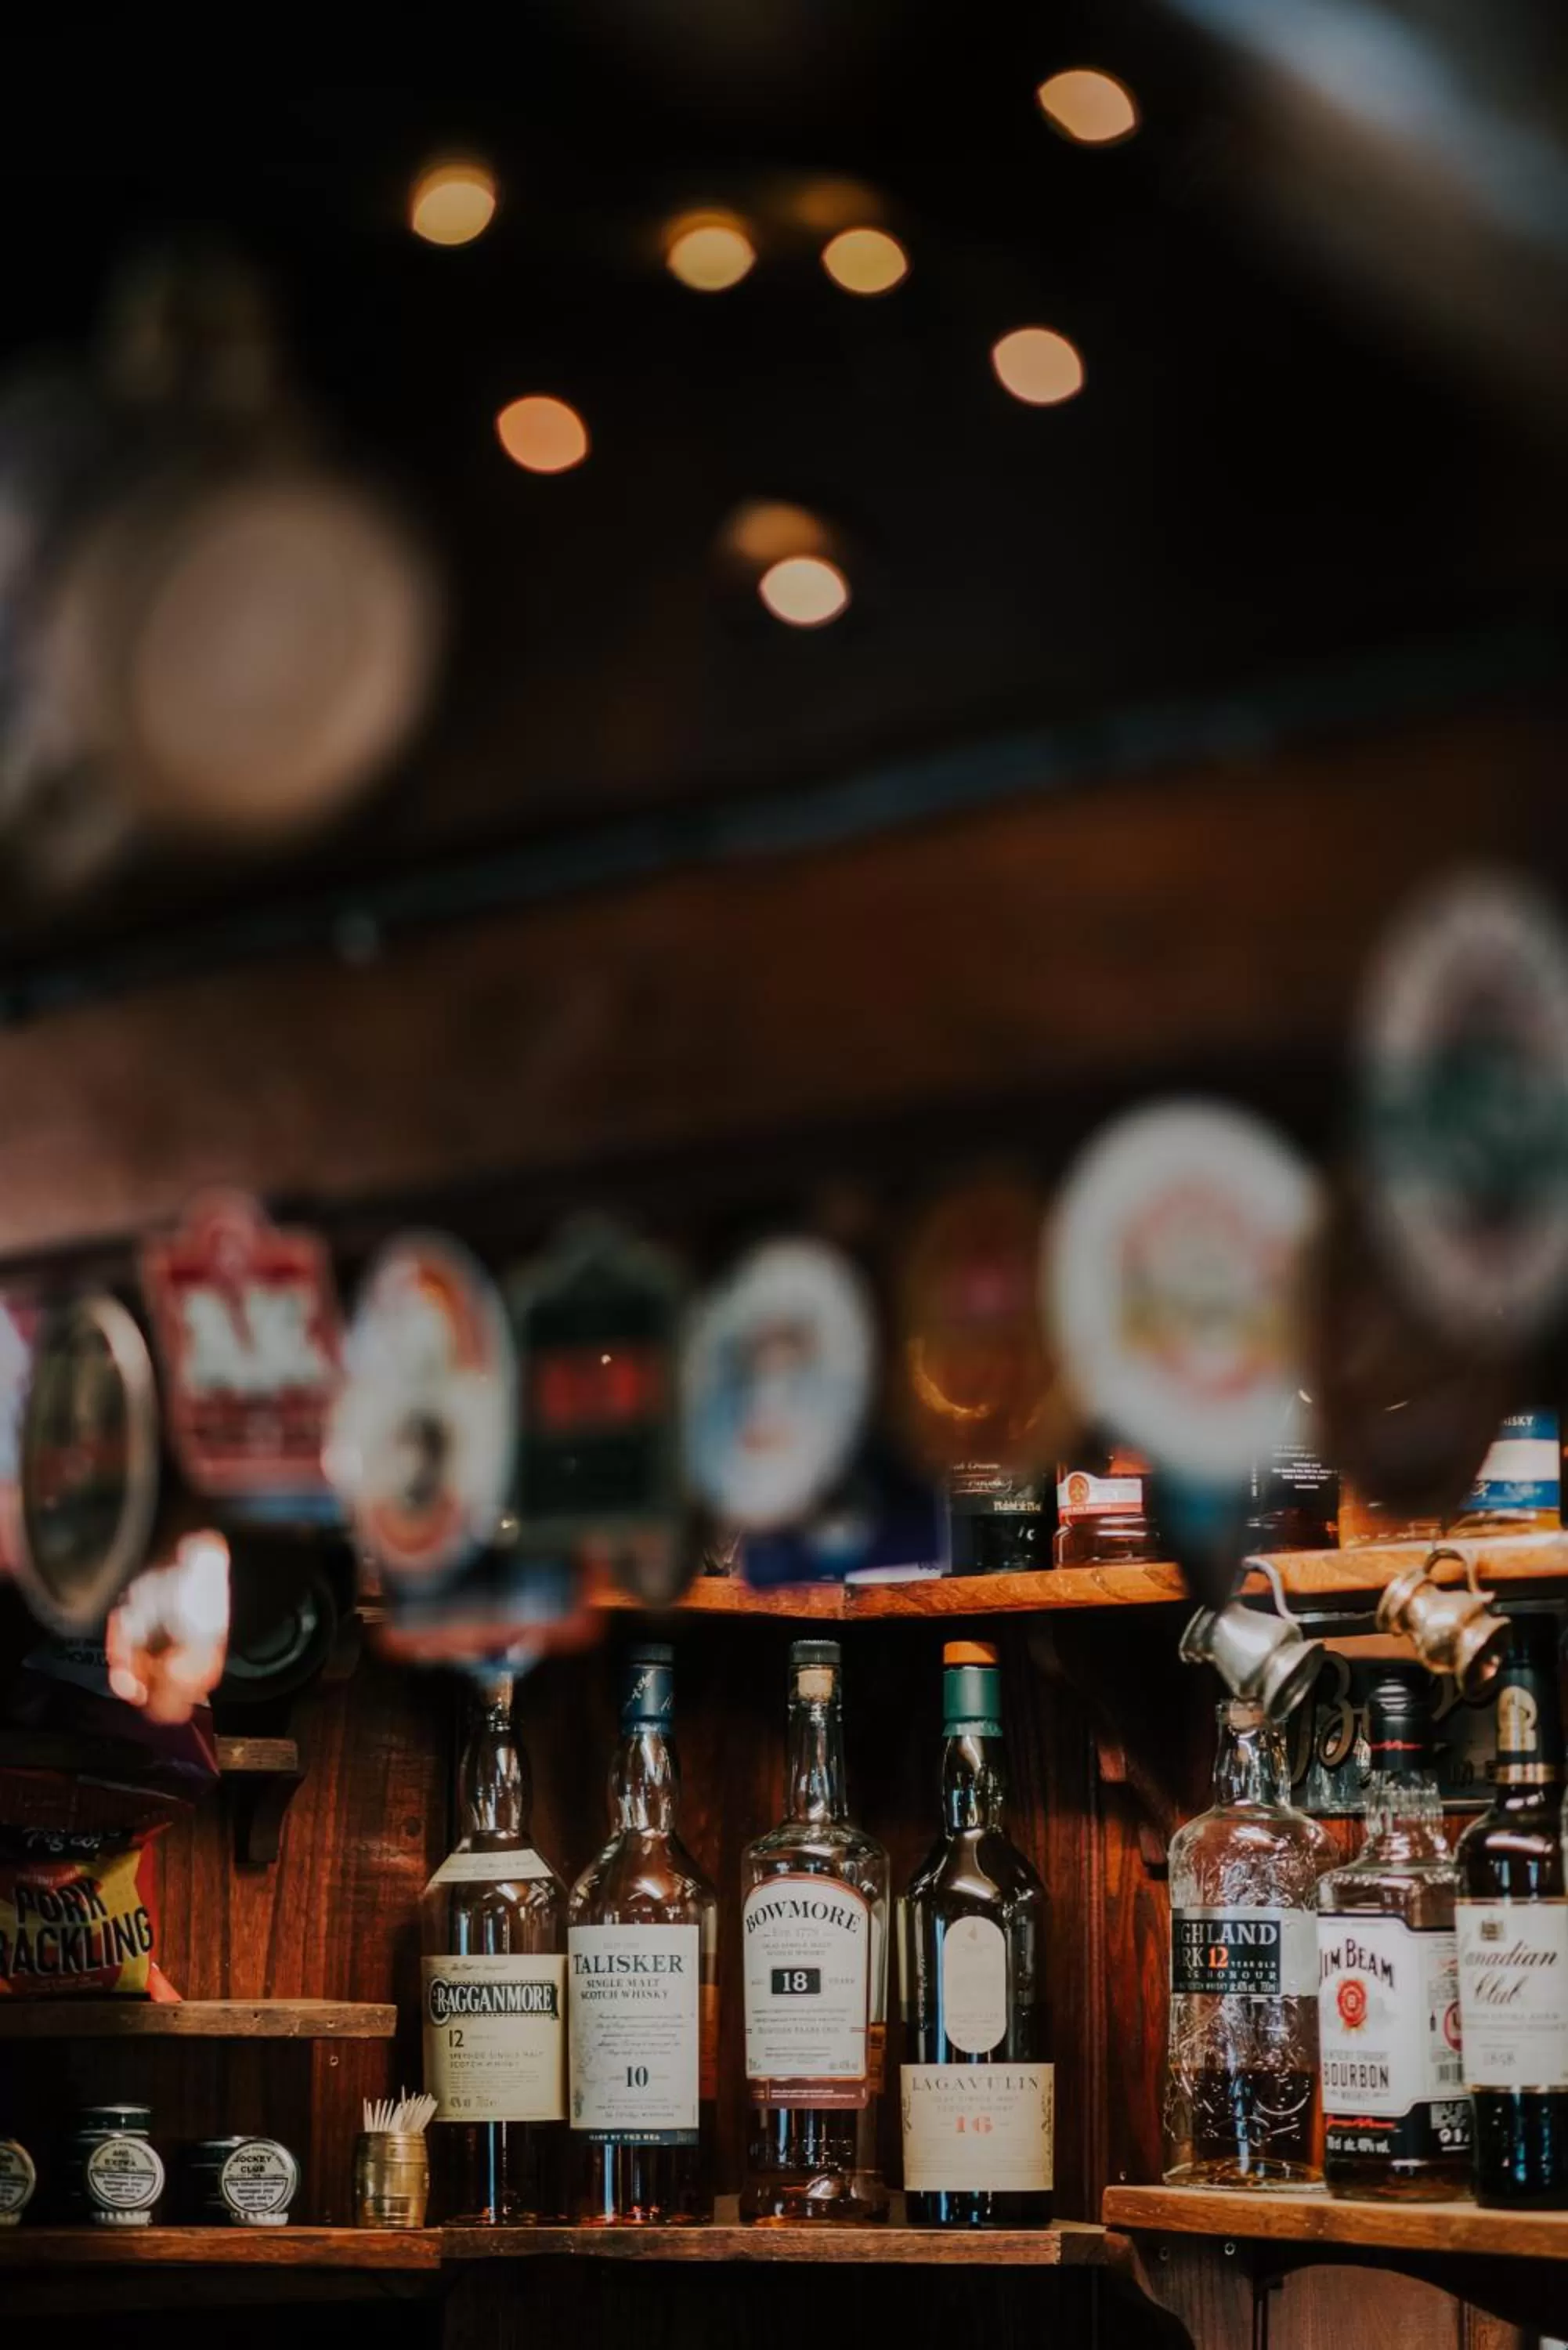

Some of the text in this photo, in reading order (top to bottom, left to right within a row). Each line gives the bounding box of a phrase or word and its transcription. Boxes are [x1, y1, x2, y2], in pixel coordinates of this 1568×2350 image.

[14, 1878, 109, 1925] PORK
[746, 1900, 861, 1934] BOWMORE
[573, 1953, 684, 1974] TALISKER
[1209, 1946, 1230, 1969] 12
[1319, 1947, 1342, 1987] JIM
[1346, 1938, 1393, 1988] BEAM
[587, 1979, 660, 1988] SINGLE MALT
[782, 1972, 807, 1992] 18
[580, 1990, 668, 1999] SCOTCH WHISKY
[449, 2030, 464, 2048] 12
[626, 2066, 649, 2088] 10
[912, 2077, 1040, 2092] LAGAVULIN
[1324, 2062, 1389, 2088] BOURBON
[956, 2115, 994, 2134] 16
